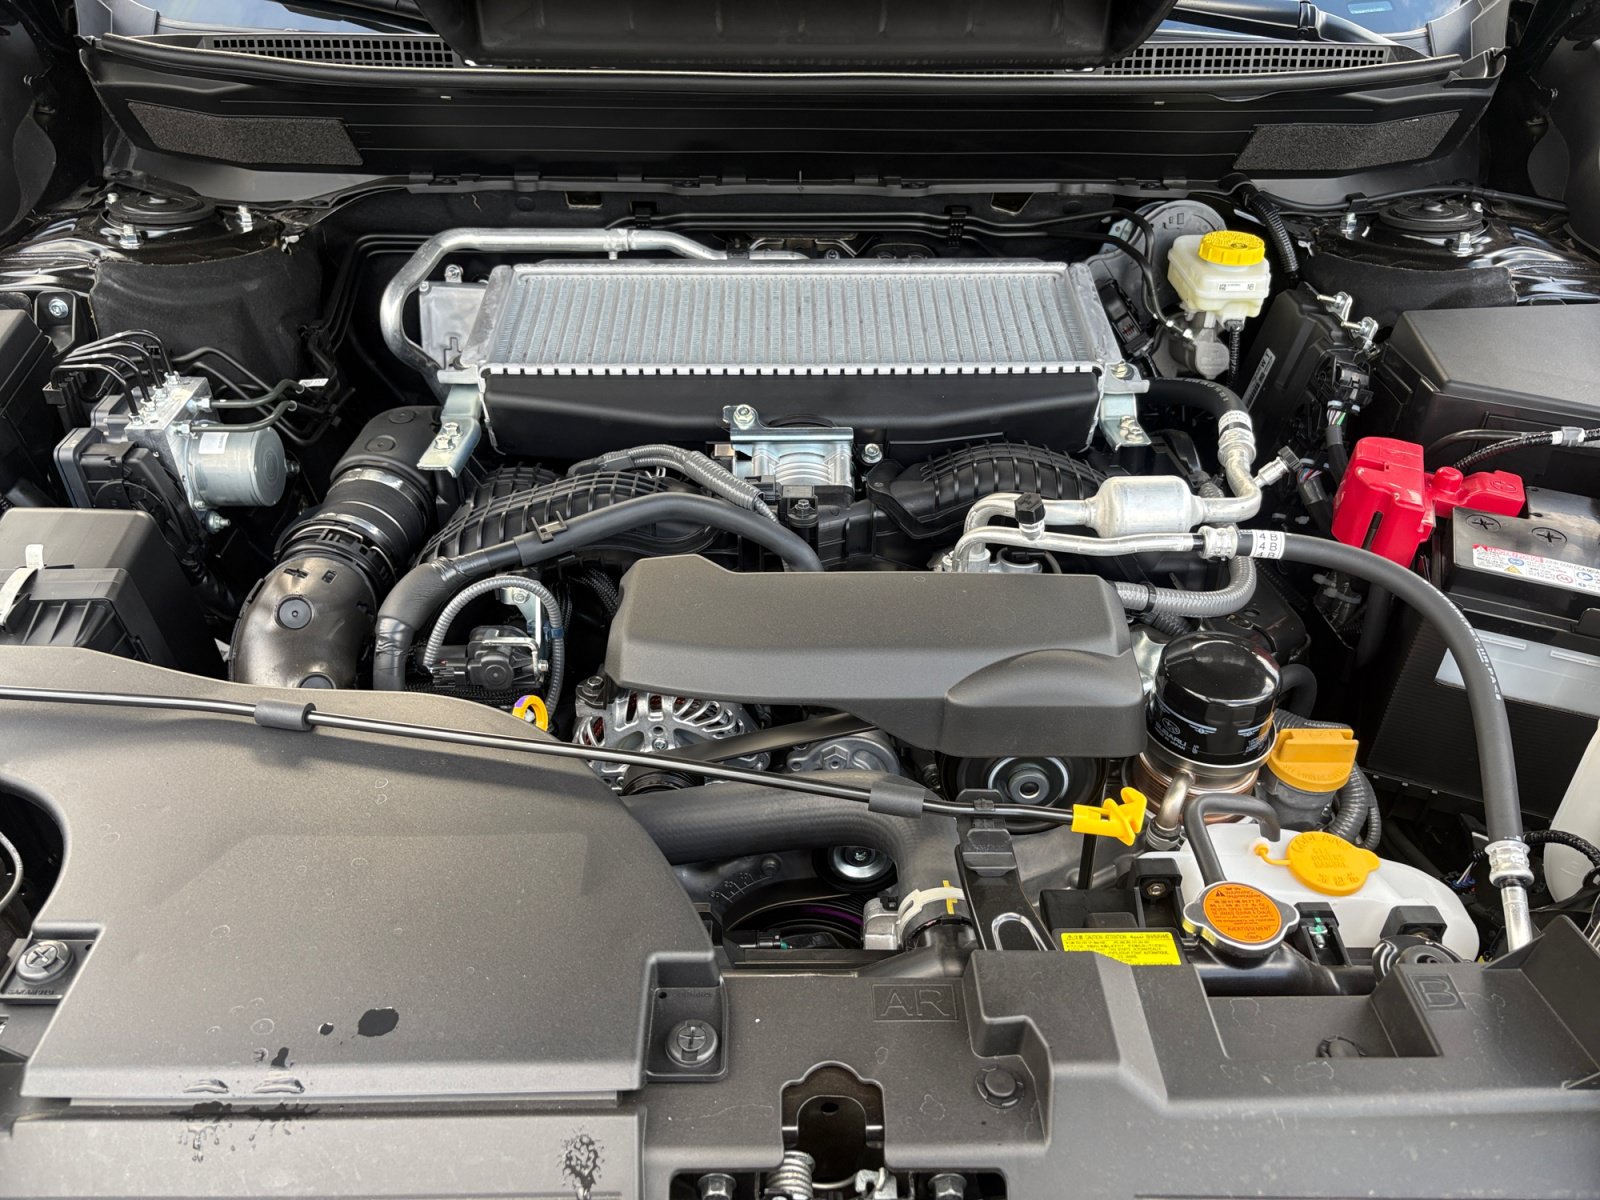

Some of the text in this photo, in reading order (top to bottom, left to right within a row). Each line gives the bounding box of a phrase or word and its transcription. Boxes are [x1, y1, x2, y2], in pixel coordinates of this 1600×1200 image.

[1258, 542, 1278, 551] 4 B
[1270, 533, 1278, 541] B
[880, 988, 951, 1017] AR
[1419, 978, 1459, 1008] B
